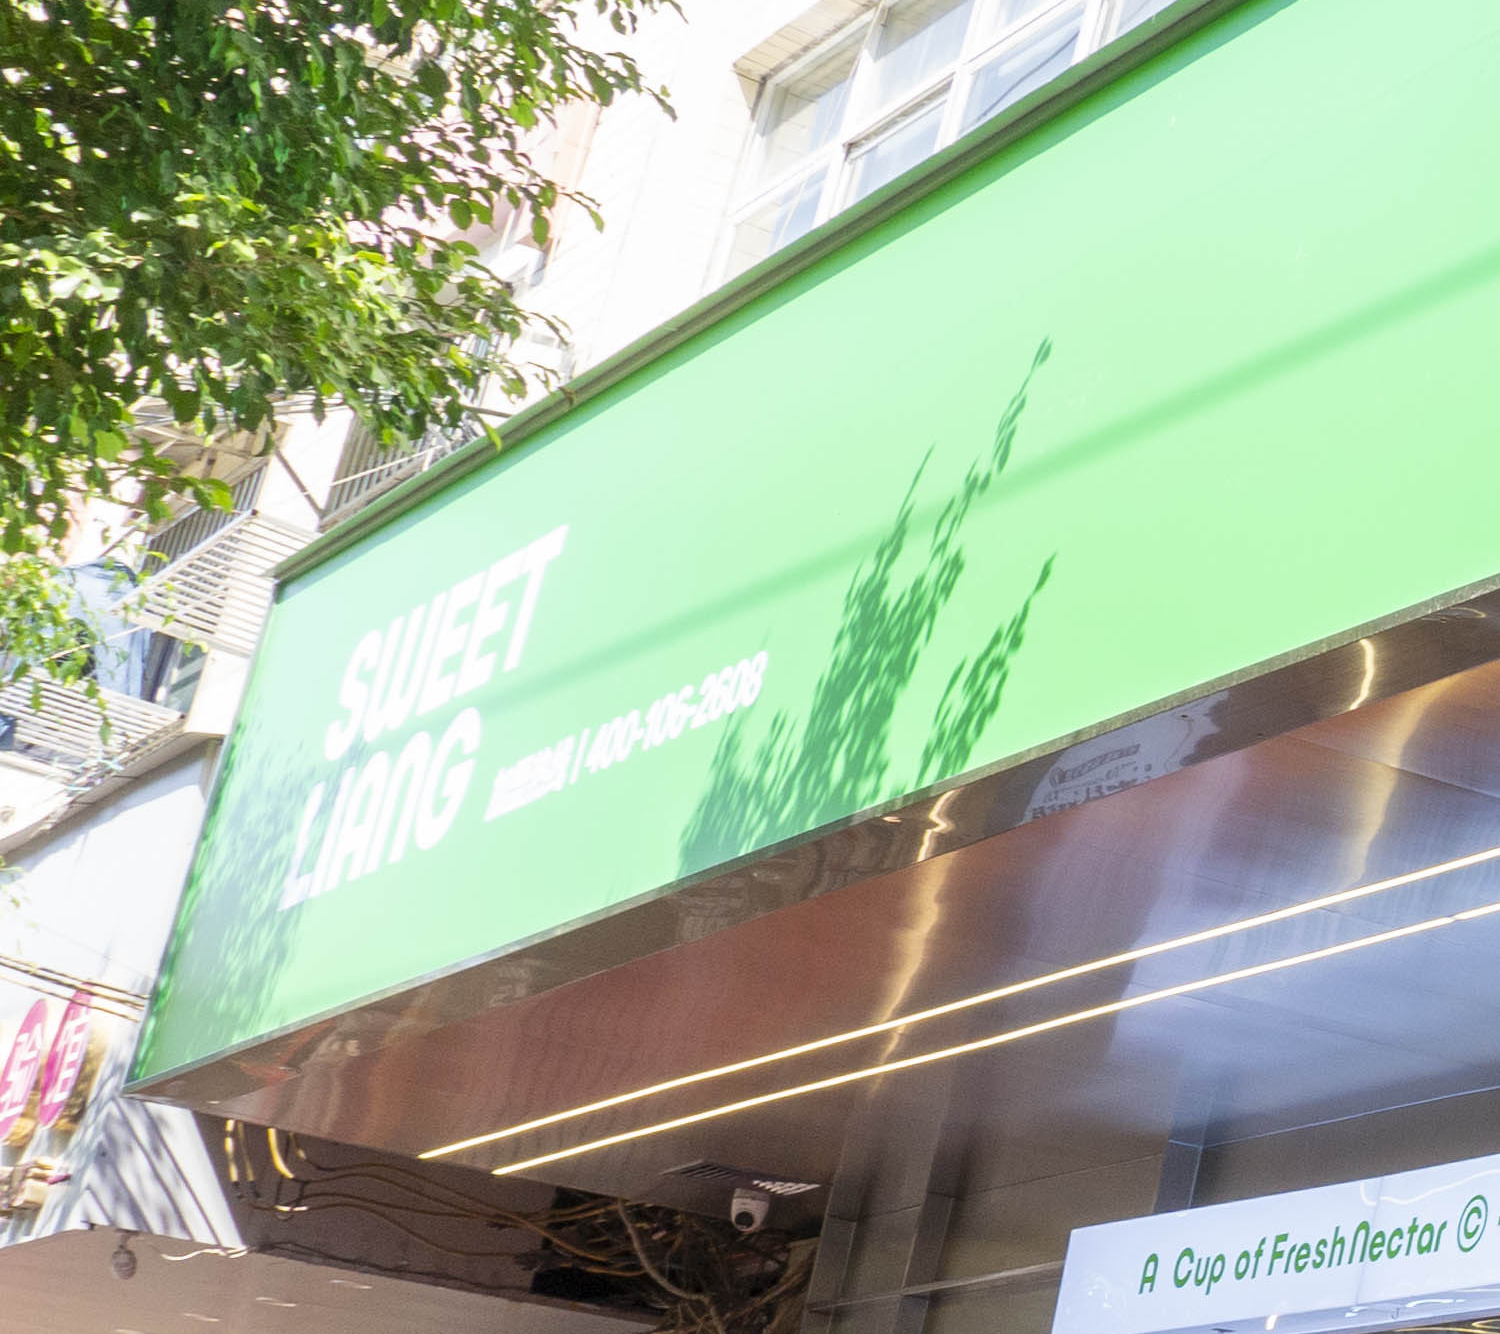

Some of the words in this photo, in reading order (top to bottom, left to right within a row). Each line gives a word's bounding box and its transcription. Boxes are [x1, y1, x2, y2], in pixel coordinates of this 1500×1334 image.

[323, 523, 569, 760] SWEET
[277, 707, 482, 912] LIANG
[1138, 1252, 1160, 1295] A
[1173, 1248, 1226, 1296] Cup
[1234, 1236, 1268, 1279] of
